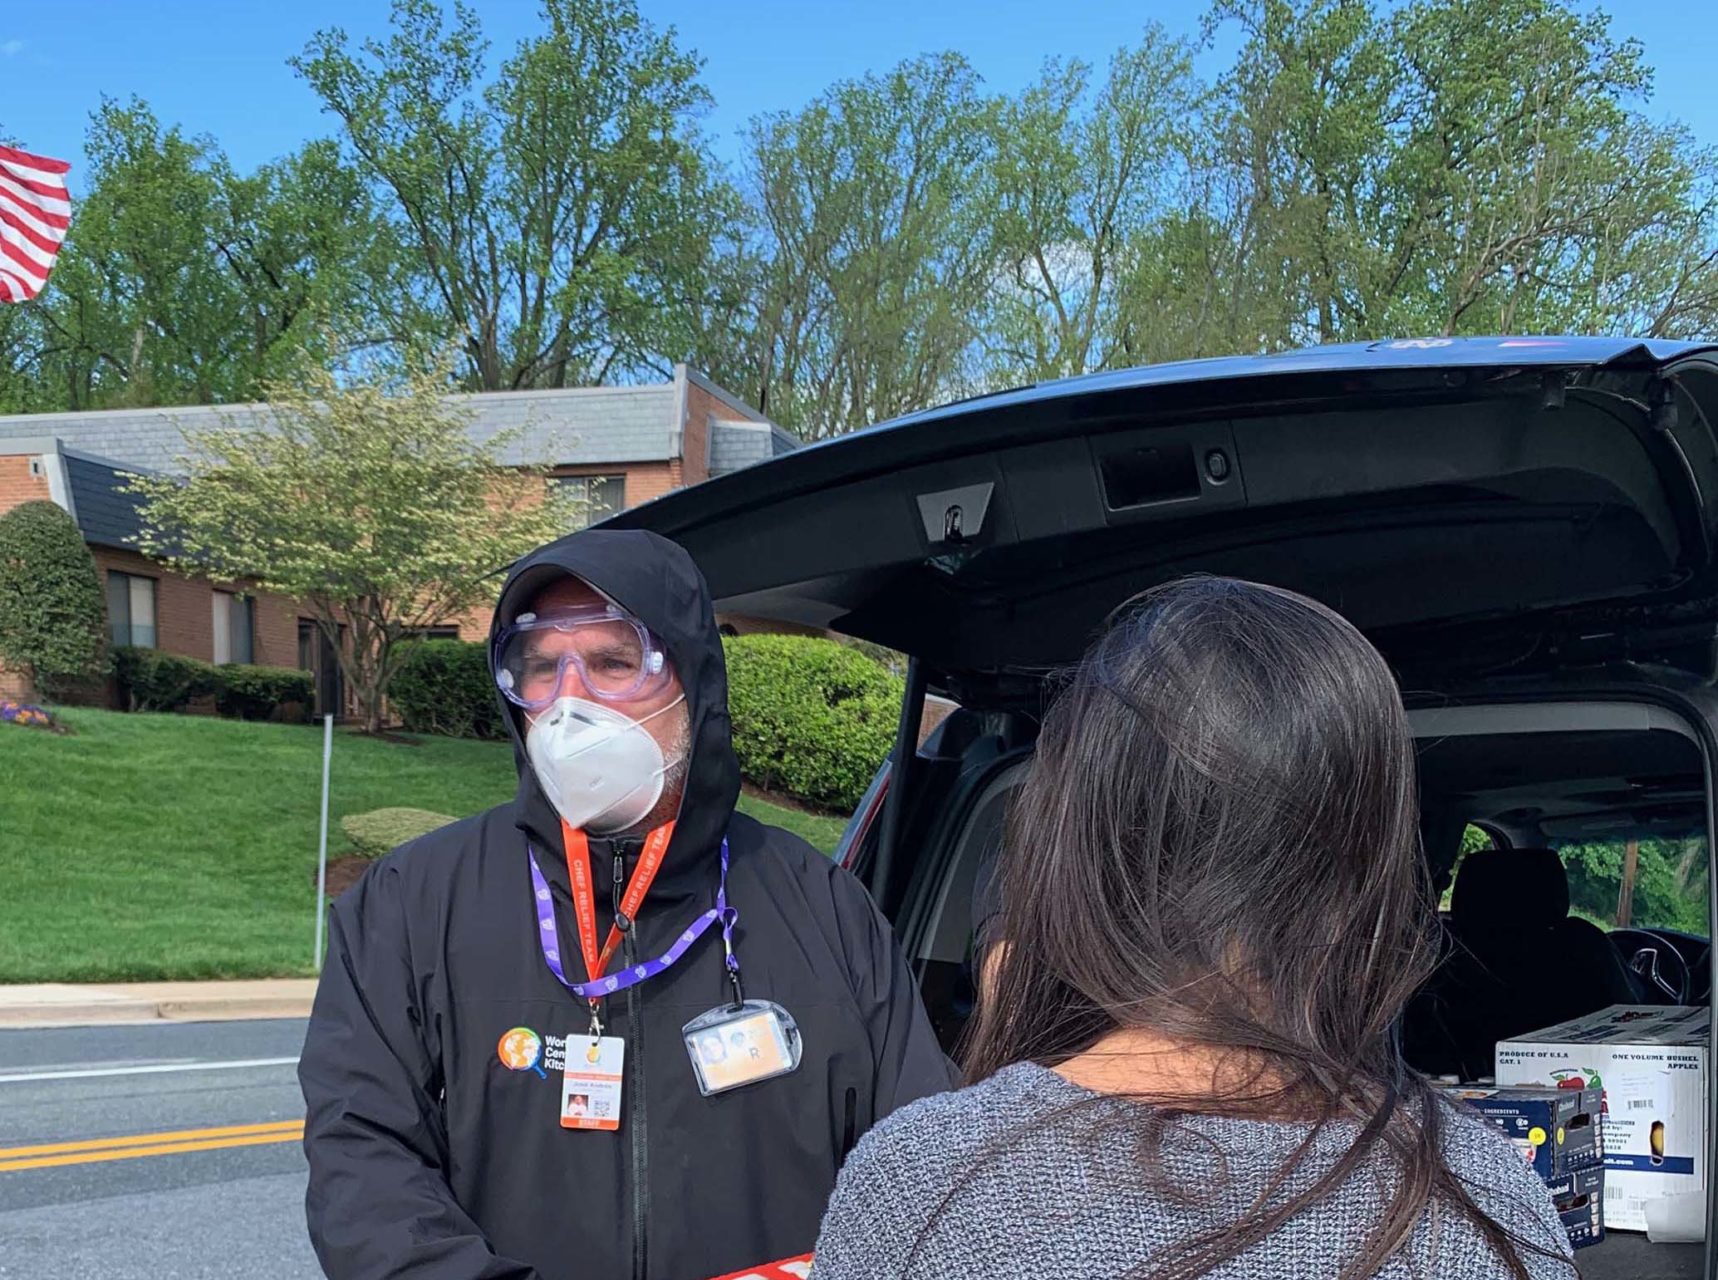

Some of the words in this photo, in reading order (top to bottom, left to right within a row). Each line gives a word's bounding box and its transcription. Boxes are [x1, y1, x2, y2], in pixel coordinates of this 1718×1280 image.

[573, 859, 587, 889] CHEF
[637, 854, 657, 891] RELIEF
[578, 891, 592, 930] RELIEF
[584, 932, 595, 963] TEAM
[545, 1035, 567, 1048] Wor
[545, 1047, 566, 1059] Cen
[544, 1058, 565, 1070] Kitc
